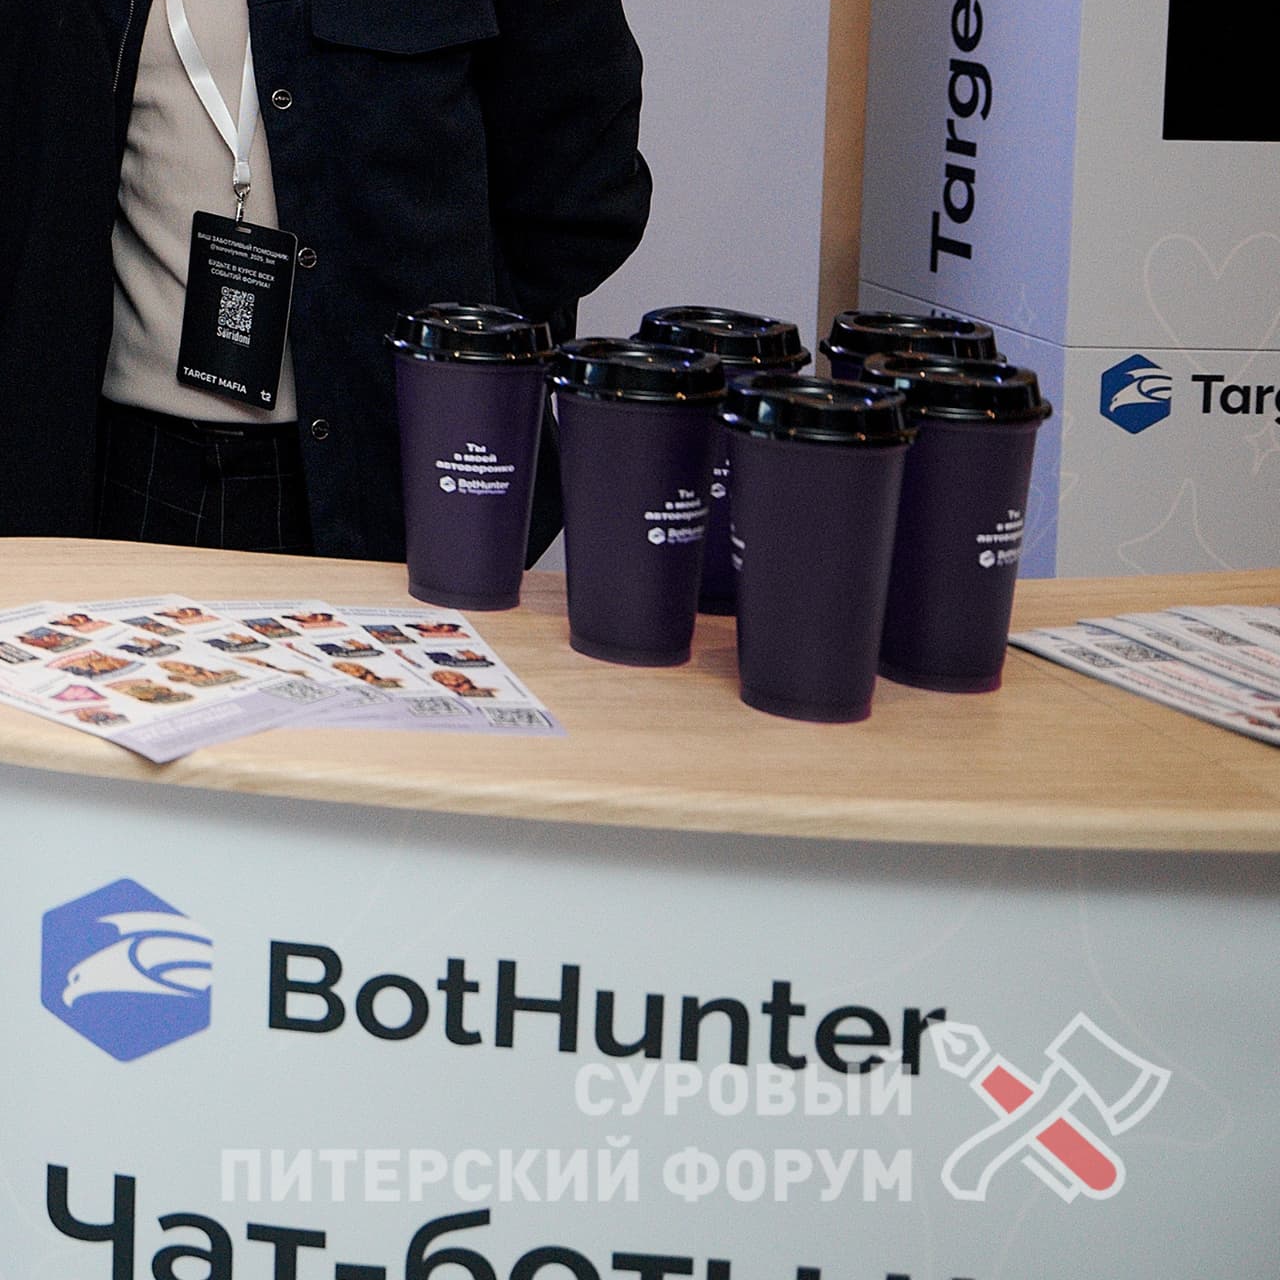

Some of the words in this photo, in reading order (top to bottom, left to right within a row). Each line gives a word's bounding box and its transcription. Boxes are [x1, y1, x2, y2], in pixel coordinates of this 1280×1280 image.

[183, 366, 218, 385] TARGET
[217, 376, 248, 394] MAFIA
[260, 389, 272, 402] t2
[1191, 374, 1280, 426] Tar
[466, 442, 487, 453] Ты
[458, 478, 510, 490] BotHunter
[267, 938, 947, 1076] BotHunter
